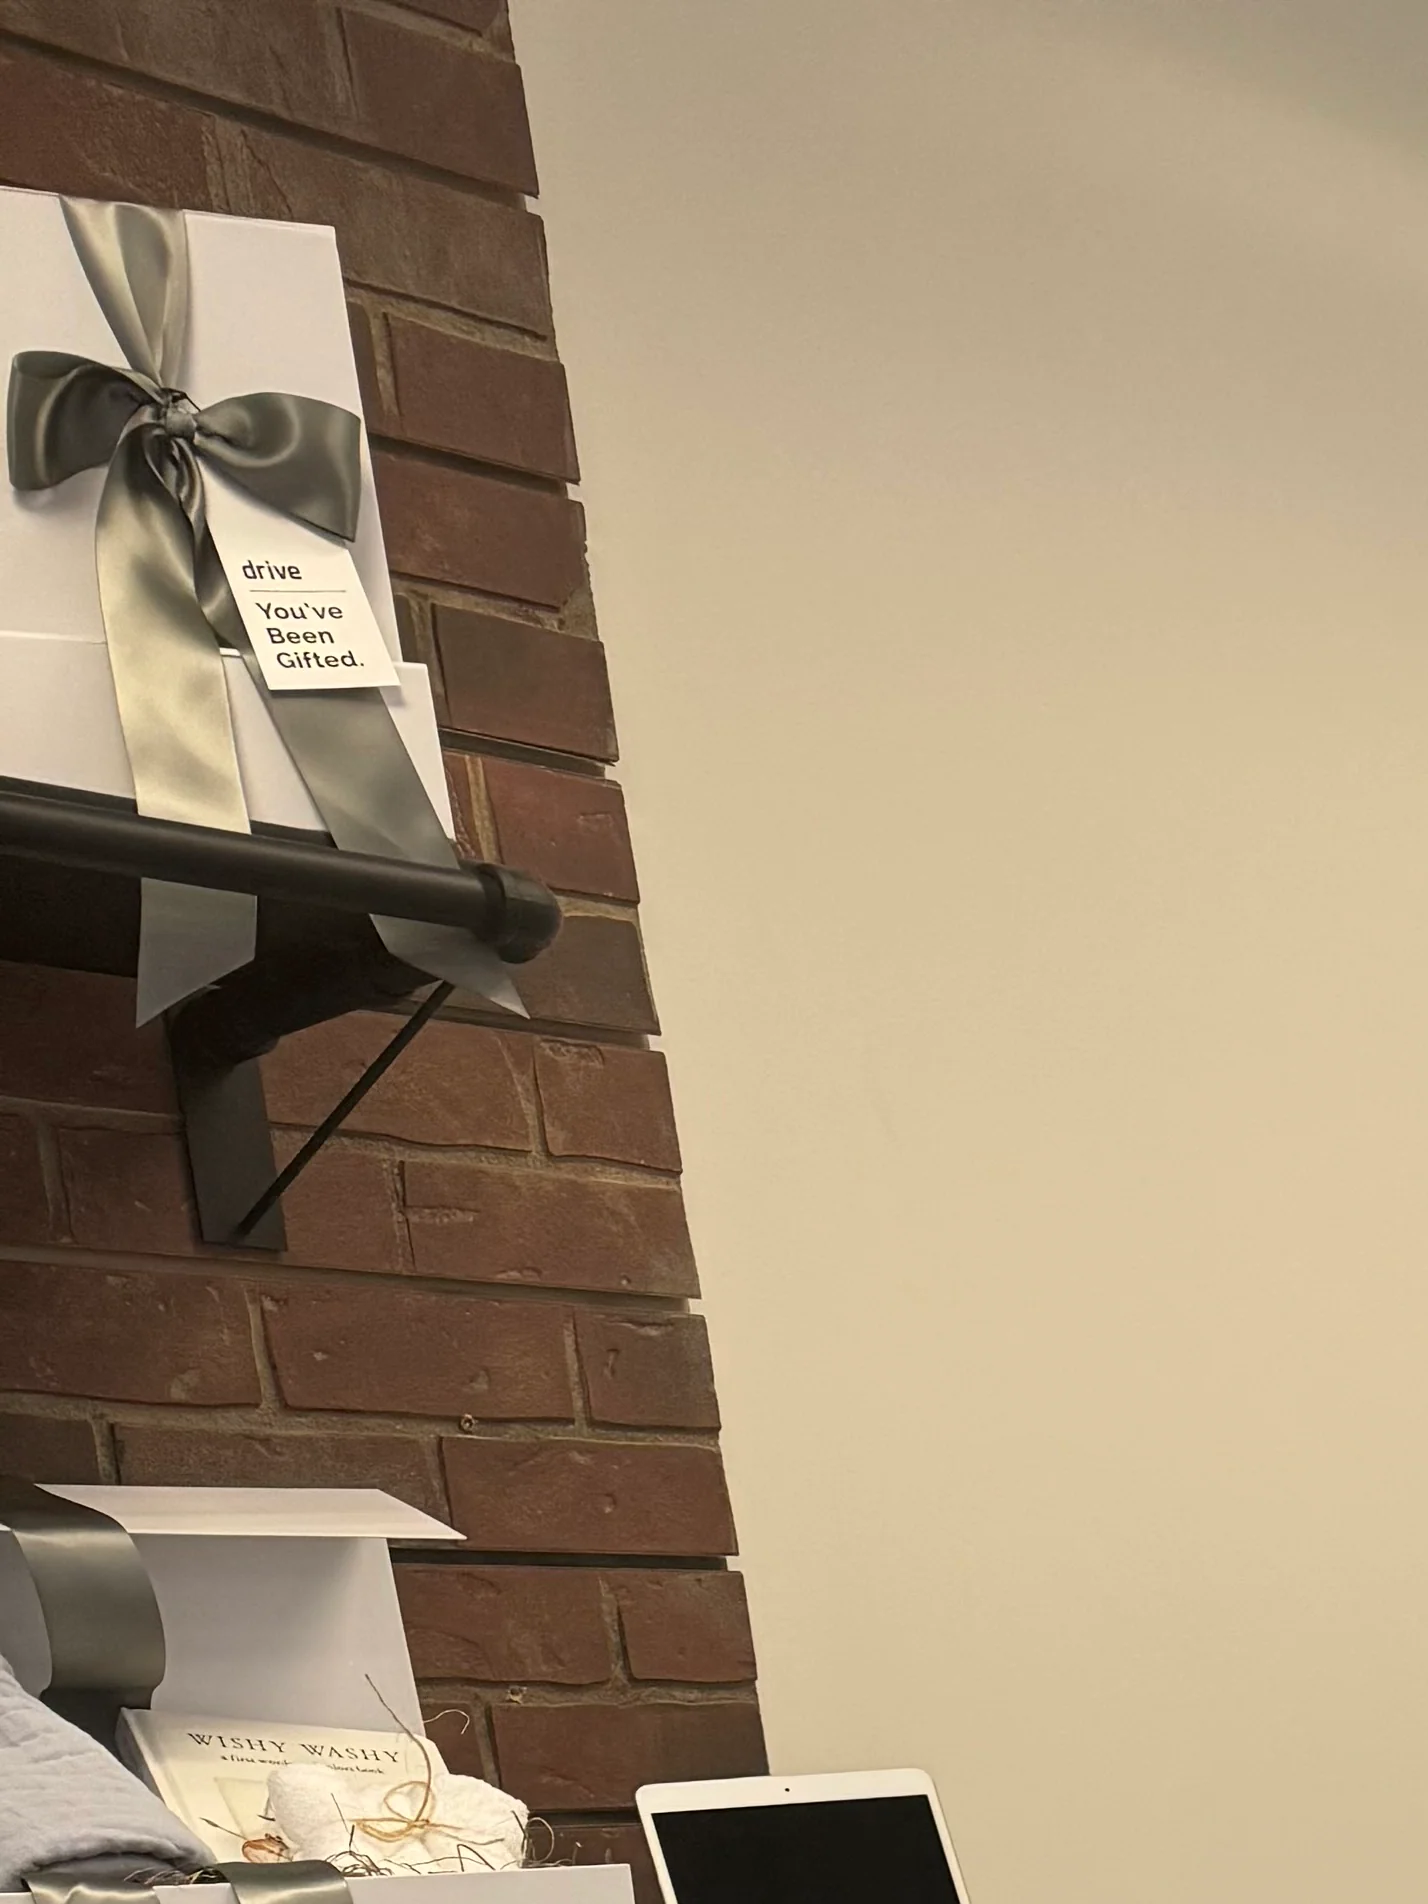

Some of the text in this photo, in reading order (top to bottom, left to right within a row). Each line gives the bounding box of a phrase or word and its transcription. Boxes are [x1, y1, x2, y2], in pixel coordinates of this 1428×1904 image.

[242, 560, 302, 580] drive
[255, 602, 343, 620] You've
[266, 627, 335, 644] Been
[276, 650, 364, 668] Gifted.
[187, 1732, 399, 1763] WISHY WASHY
